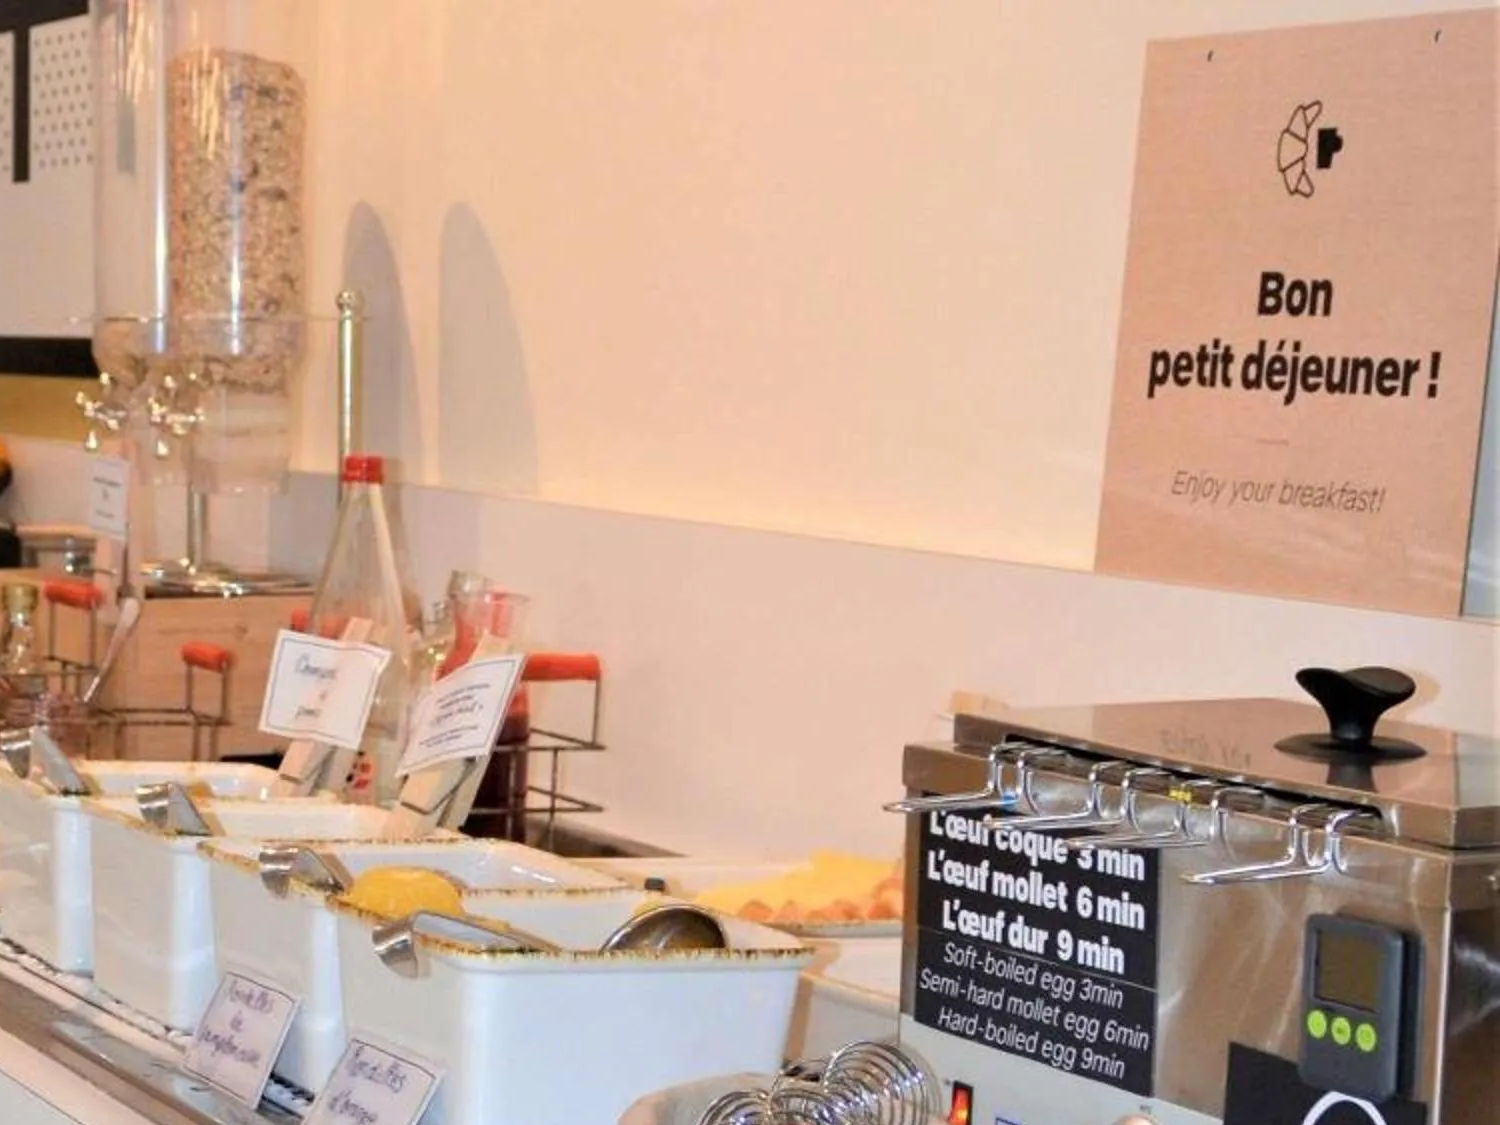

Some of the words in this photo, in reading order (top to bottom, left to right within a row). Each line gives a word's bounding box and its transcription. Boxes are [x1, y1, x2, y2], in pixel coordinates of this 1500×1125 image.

[1257, 271, 1333, 317] Bon
[1147, 338, 1235, 400] petit
[1240, 339, 1421, 407] déjeuner
[1171, 469, 1226, 504] Enjoy
[1229, 479, 1275, 508] your
[1278, 479, 1387, 514] breakfast!
[995, 826, 1068, 867] coque
[1077, 844, 1093, 870] 3
[1097, 848, 1145, 881] min
[992, 869, 1068, 912] mollet
[1076, 886, 1093, 918] 6
[1097, 892, 1145, 930] min
[1008, 915, 1049, 954] dur
[1057, 929, 1073, 961] 9
[1077, 935, 1125, 974] min
[943, 942, 1038, 985] Soft-boiled
[1041, 973, 1075, 1002] egg
[1079, 979, 1123, 1009] 3min
[919, 968, 1004, 1009] Semi-hard
[1006, 998, 1061, 1027] mollet
[1064, 1013, 1099, 1043] egg
[1104, 1020, 1149, 1050] 6min
[938, 1006, 1038, 1053] Hard-boiled
[1041, 1040, 1077, 1070] egg
[1081, 1048, 1125, 1079] 9min
